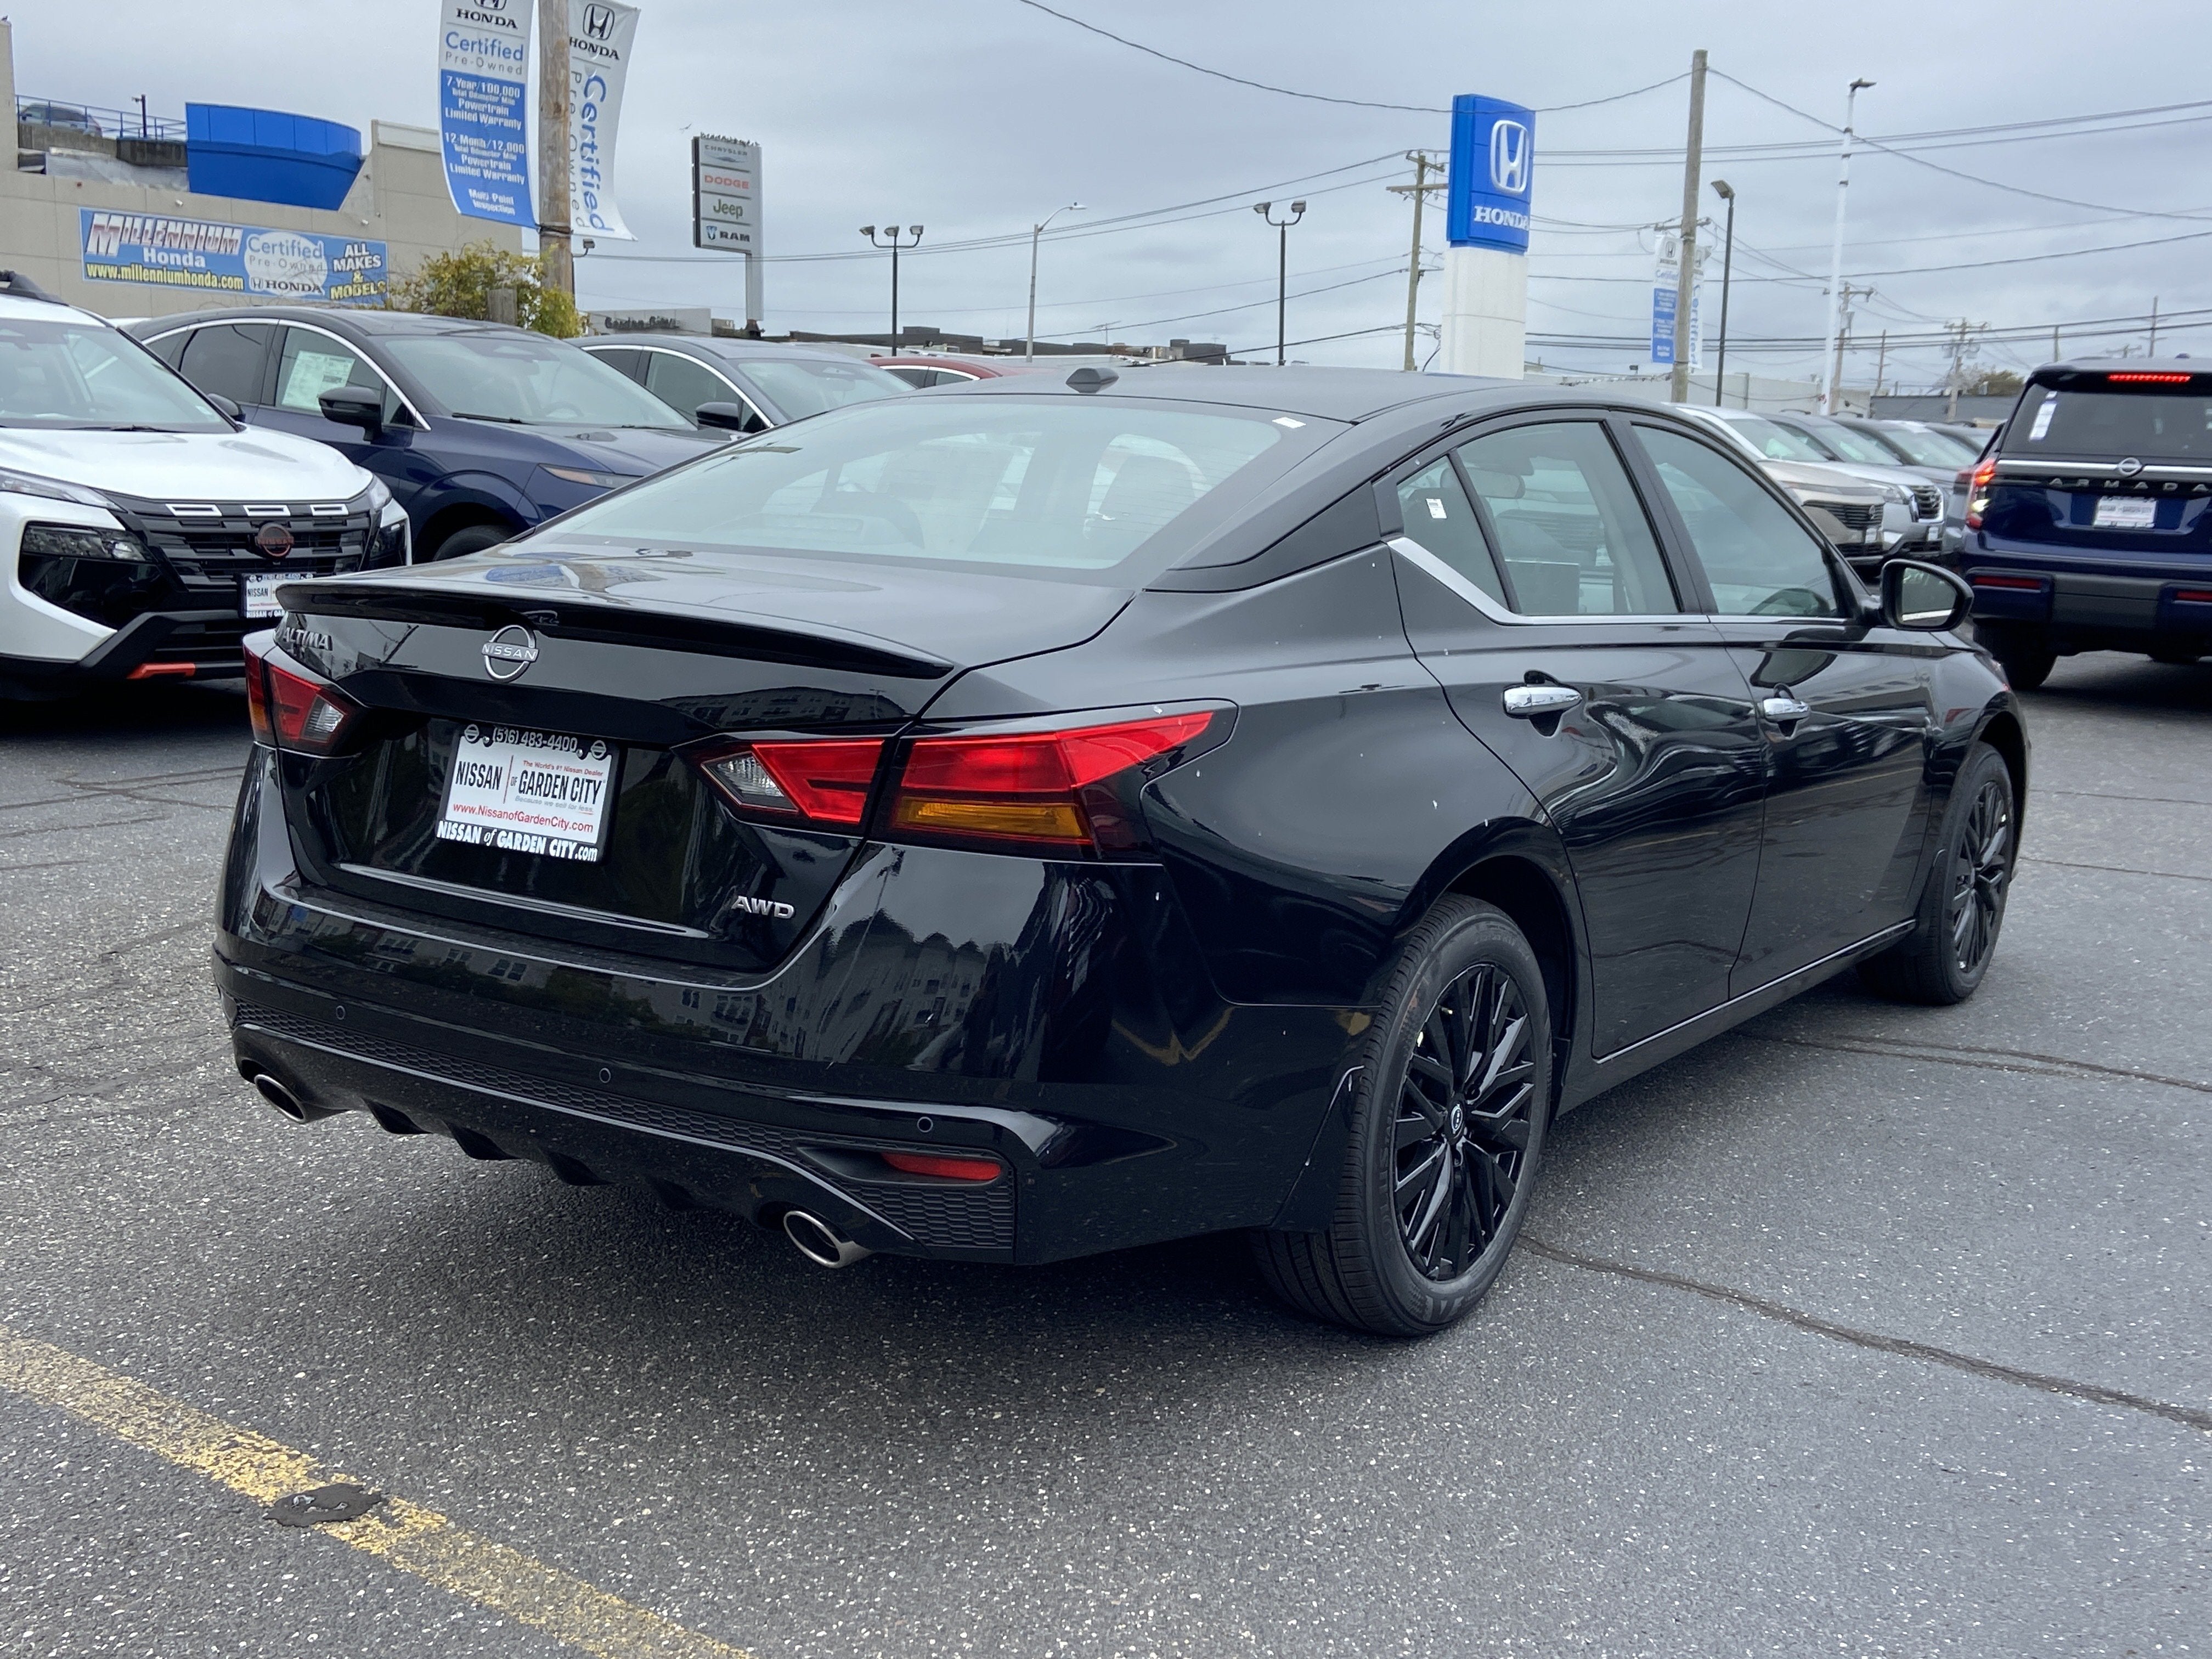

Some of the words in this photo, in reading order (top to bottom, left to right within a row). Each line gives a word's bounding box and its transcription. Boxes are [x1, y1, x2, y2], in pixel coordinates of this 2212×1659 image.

[456, 8, 518, 30] HONDA
[445, 31, 524, 61] Certified
[569, 36, 620, 60] HONDA
[445, 51, 523, 75] Pre-Owned
[458, 97, 509, 116] Powertrain
[445, 106, 478, 122] Limited
[479, 112, 522, 131] Warranty
[580, 75, 614, 231] Certified
[704, 144, 748, 156] CHRYSLER
[461, 154, 511, 171] Powertrain
[450, 162, 481, 177] Limited
[483, 168, 526, 185] Warranty
[704, 175, 749, 190] DODGE
[713, 199, 743, 219] Jeep
[1474, 205, 1530, 231] HONDA
[87, 212, 243, 257] MILLENNIUM
[719, 230, 751, 242] RAM
[143, 247, 206, 268] Honda
[248, 236, 323, 259] Certified
[345, 242, 370, 258] ALL
[333, 255, 382, 272] MAKES
[86, 262, 244, 291] www.millenniumhonda.com
[266, 279, 322, 294] HONDA
[353, 270, 364, 283] &
[330, 280, 387, 300] MODELS
[2049, 477, 2209, 492] ARMADA
[247, 588, 268, 597] NISSAN
[247, 610, 267, 618] NISSAN
[274, 609, 285, 617] GAR
[283, 627, 329, 650] ALTIMA
[482, 644, 536, 659] NISSAN
[493, 726, 520, 744] (516)
[521, 731, 578, 753] 483-4400
[455, 761, 503, 791] NISSAN
[534, 761, 555, 770] World's
[563, 766, 583, 774] Nissan
[584, 768, 603, 777] Dealer
[518, 770, 569, 800] GARDEN
[570, 777, 602, 805] CITY
[515, 795, 542, 805] Because
[555, 802, 567, 810] sell
[453, 802, 594, 833] www.NissanofGardenCity.com
[436, 820, 482, 844] NISSAN
[483, 828, 498, 847] of
[496, 830, 547, 855] GARDEN
[549, 838, 599, 862] CITY.com
[731, 895, 795, 919] AWD
